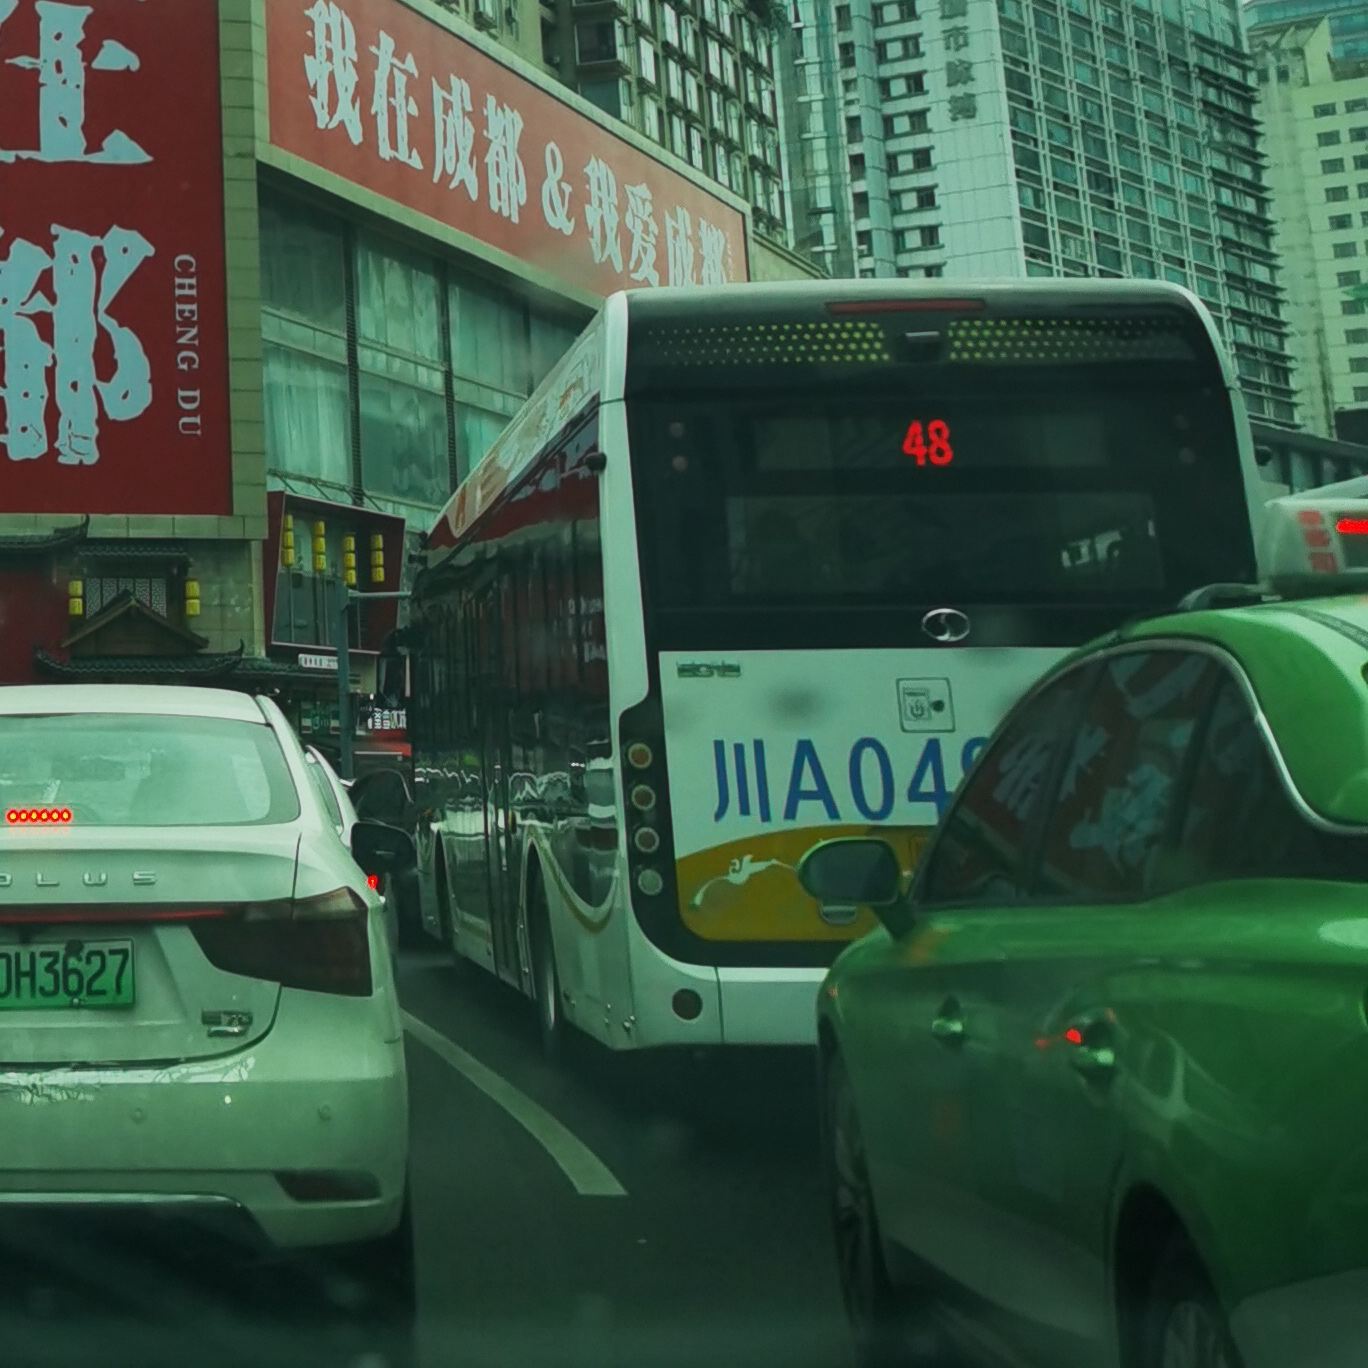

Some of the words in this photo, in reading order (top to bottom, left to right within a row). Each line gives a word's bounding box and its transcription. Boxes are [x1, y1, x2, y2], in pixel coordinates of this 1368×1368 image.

[173, 253, 200, 372] CHENG
[177, 388, 202, 436] DU
[901, 419, 953, 466] 48
